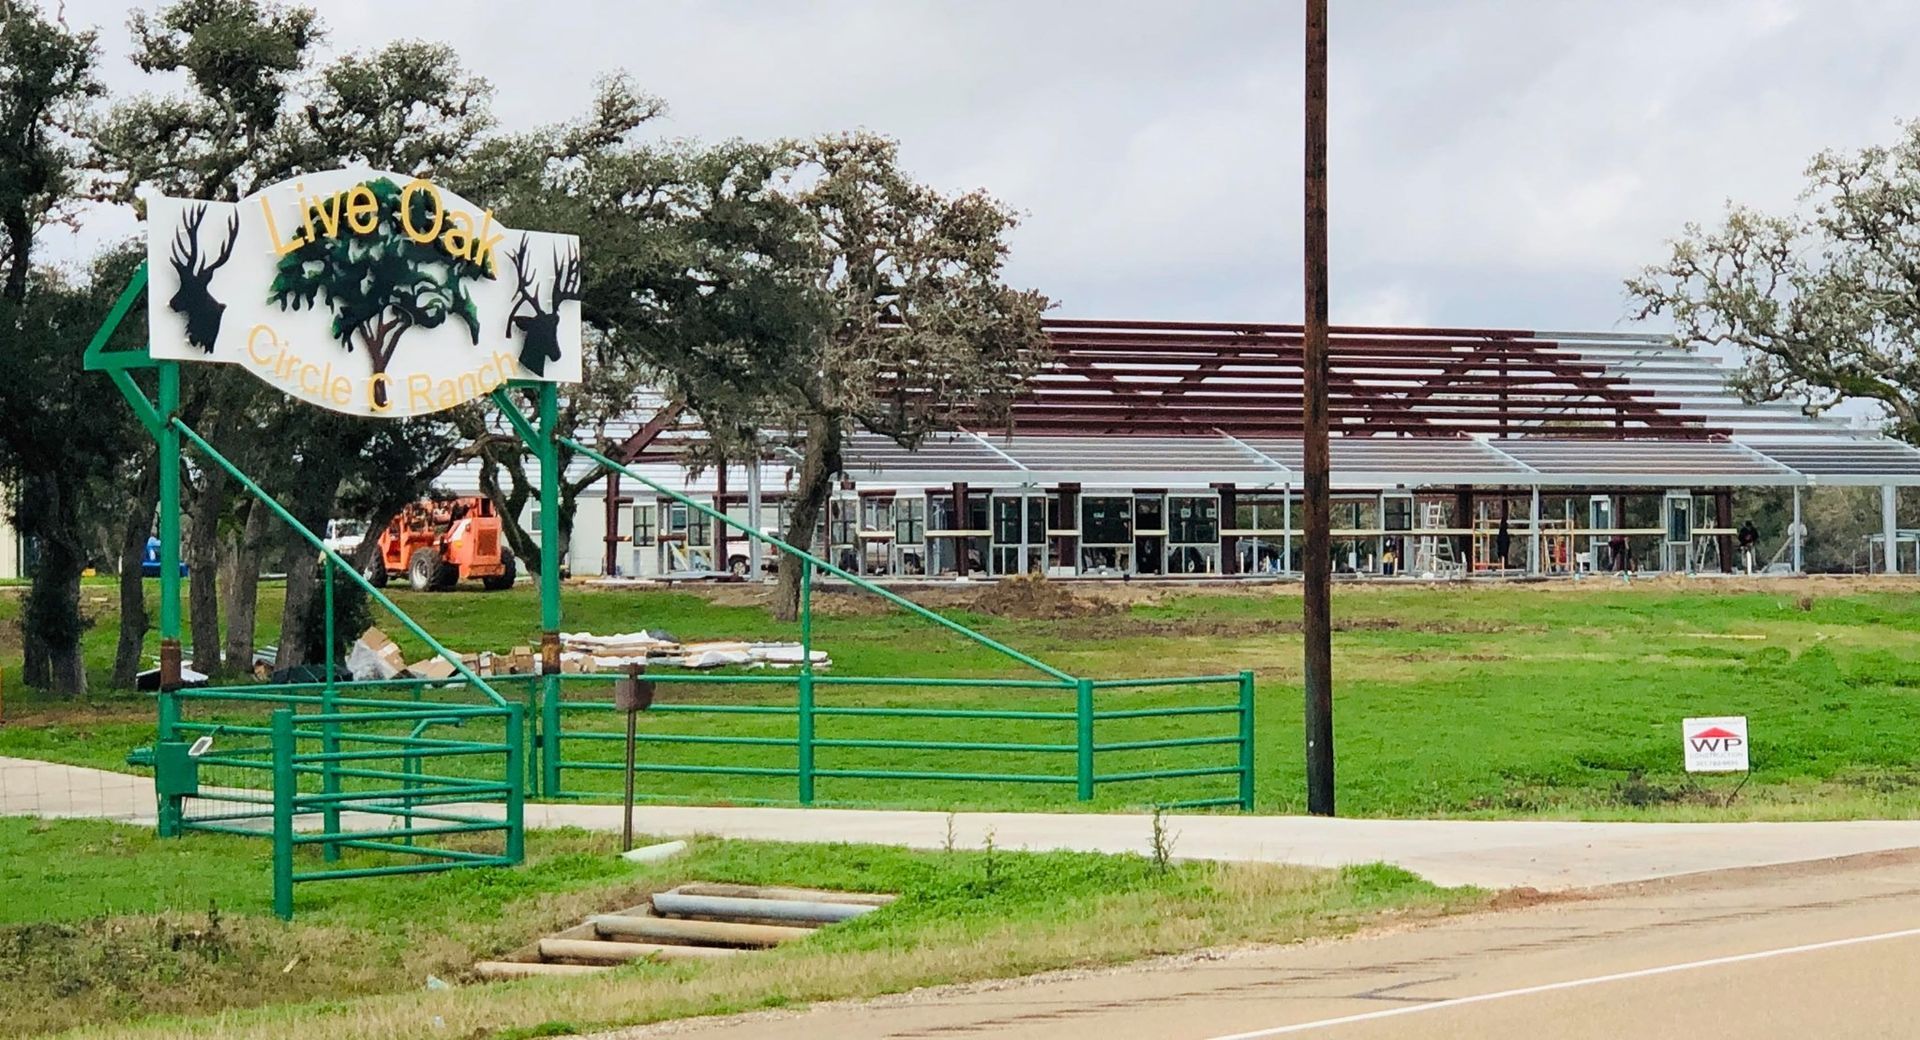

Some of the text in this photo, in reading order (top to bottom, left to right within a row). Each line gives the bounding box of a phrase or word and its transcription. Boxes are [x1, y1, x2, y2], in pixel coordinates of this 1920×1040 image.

[261, 178, 504, 277] Live Oak
[248, 324, 518, 412] Circle C Ranch
[1690, 738, 1742, 752] WP
